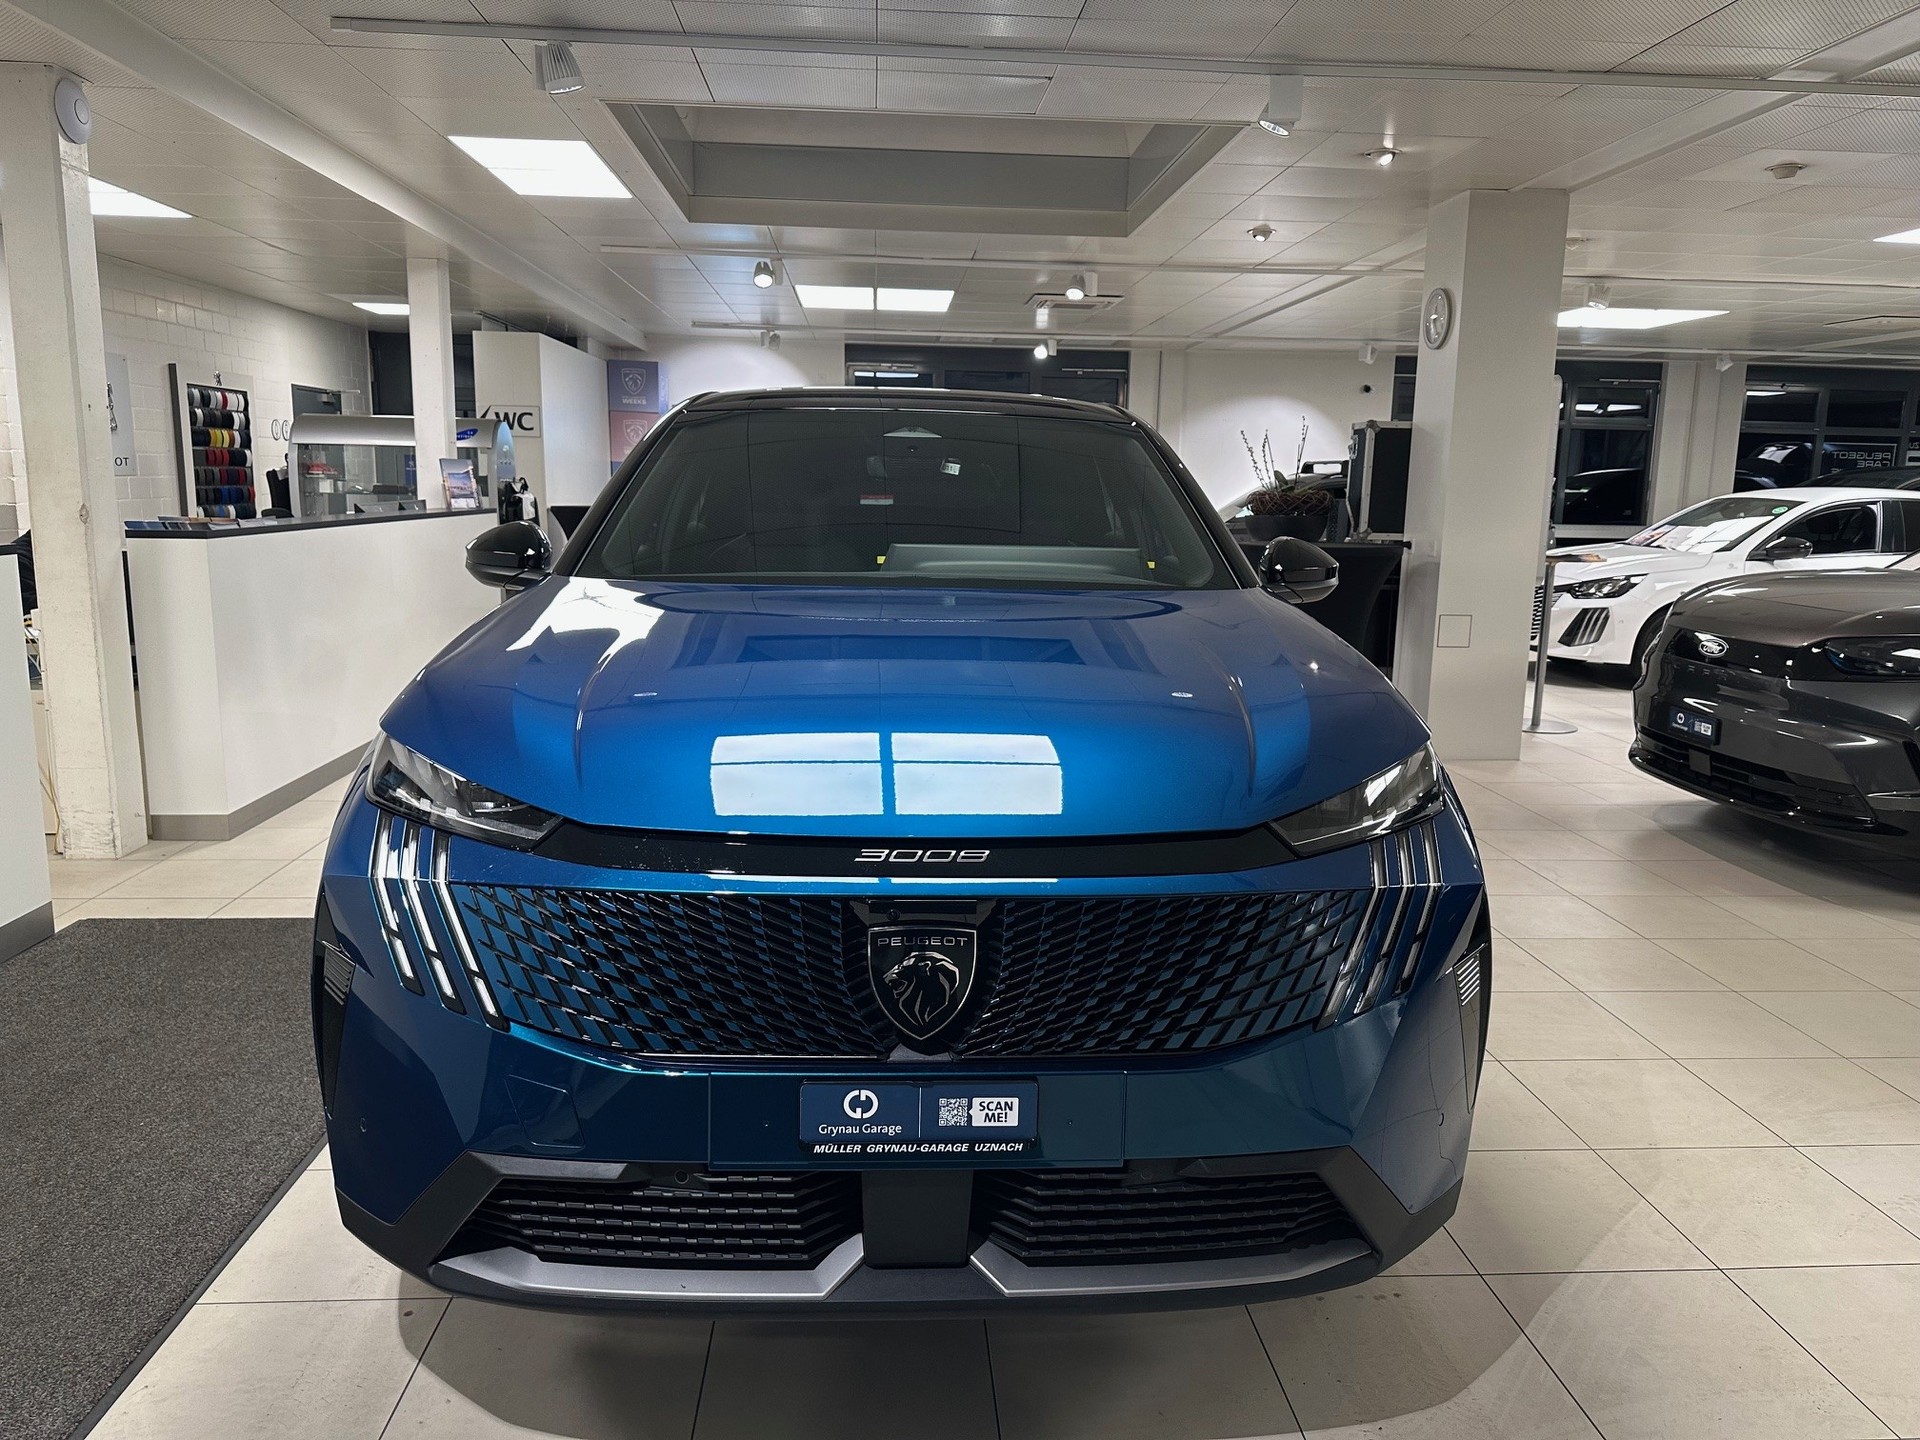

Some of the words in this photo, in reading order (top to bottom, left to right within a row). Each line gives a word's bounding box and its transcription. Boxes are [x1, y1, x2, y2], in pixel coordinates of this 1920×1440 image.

[494, 412, 534, 431] WC
[854, 849, 990, 863] 3008
[877, 936, 968, 947] PEUGEOT
[978, 1101, 1014, 1112] SCAN
[983, 1111, 1008, 1123] ME!
[818, 1124, 860, 1136] Grynau
[862, 1124, 902, 1136] Garage
[813, 1143, 862, 1154] MÜLLER
[866, 1143, 969, 1153] GRYNAU-GARAGE
[974, 1142, 1023, 1152] UZNACH
